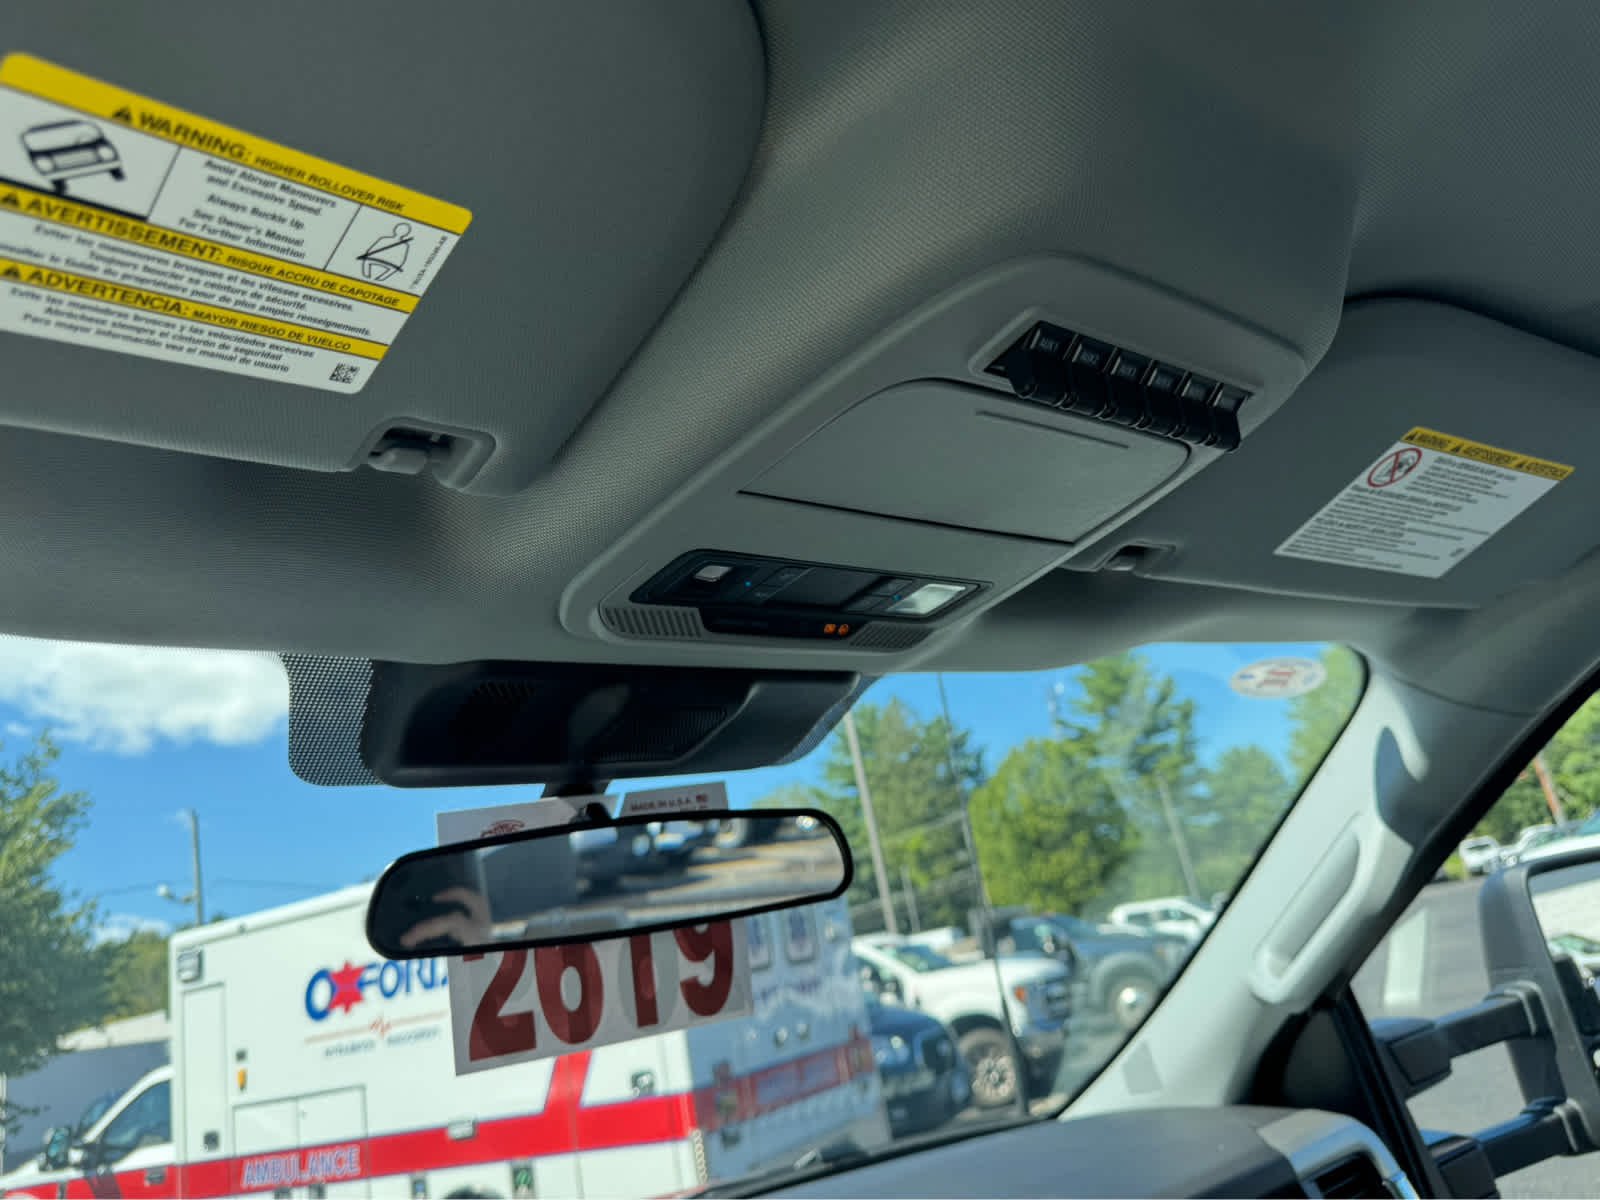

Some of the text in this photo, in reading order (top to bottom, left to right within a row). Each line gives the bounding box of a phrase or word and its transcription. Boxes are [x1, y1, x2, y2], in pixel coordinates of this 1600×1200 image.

[138, 113, 405, 210] WARNING: HIGHER ROLLOVER RISK
[279, 184, 338, 207] Maneuvers
[179, 216, 200, 229] For
[201, 224, 243, 240] Further
[194, 208, 215, 221] See
[265, 230, 305, 246] Manual
[250, 207, 288, 223] Buckle
[27, 198, 400, 304] AVERTISSEMENT: RISQUE ACCRU DE CAPOTAGE
[30, 271, 352, 348] ADVERTENCIA: MAYOR RIESGO DE VUELCO
[253, 360, 290, 371] usuario
[243, 1146, 361, 1187] AMBULANCE
